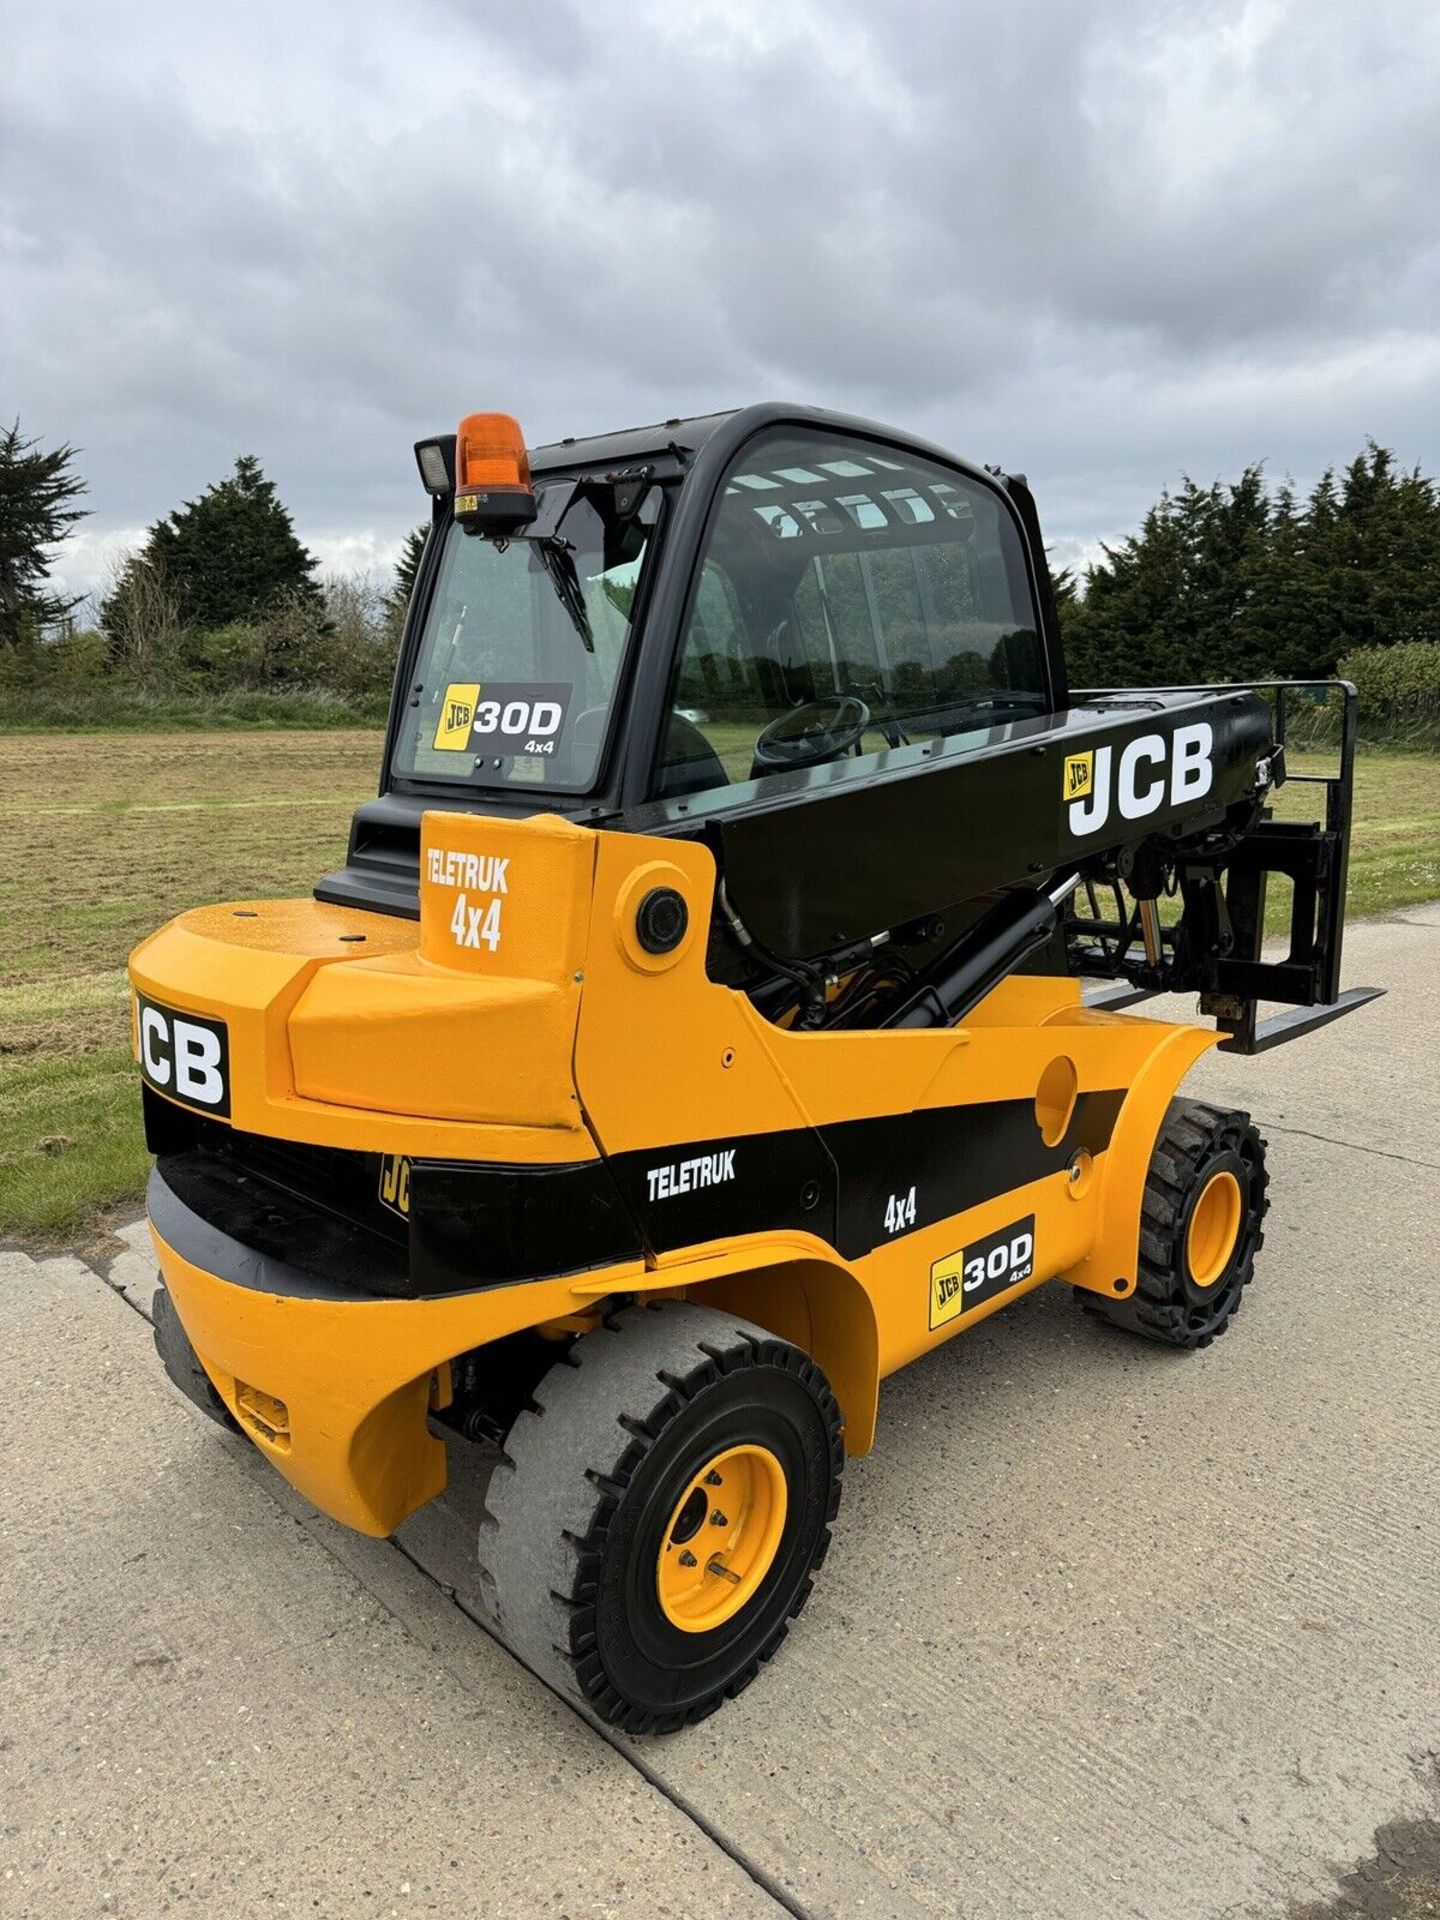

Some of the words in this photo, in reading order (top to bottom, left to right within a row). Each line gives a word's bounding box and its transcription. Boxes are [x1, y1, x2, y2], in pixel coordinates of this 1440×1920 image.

[447, 704, 470, 731] JCB
[473, 701, 562, 736] 30D
[524, 740, 554, 754] 4x4
[1069, 723, 1213, 837] JCB
[1070, 763, 1088, 791] JCB
[427, 848, 510, 895] TELETRUK
[450, 893, 502, 952] 4x4
[383, 1155, 410, 1213] JC
[647, 1149, 736, 1202] TELETRUK
[883, 1186, 917, 1234] 4x4
[938, 1275, 961, 1306] JCB
[963, 1233, 1033, 1292] 30D
[1009, 1264, 1032, 1283] 4x4
